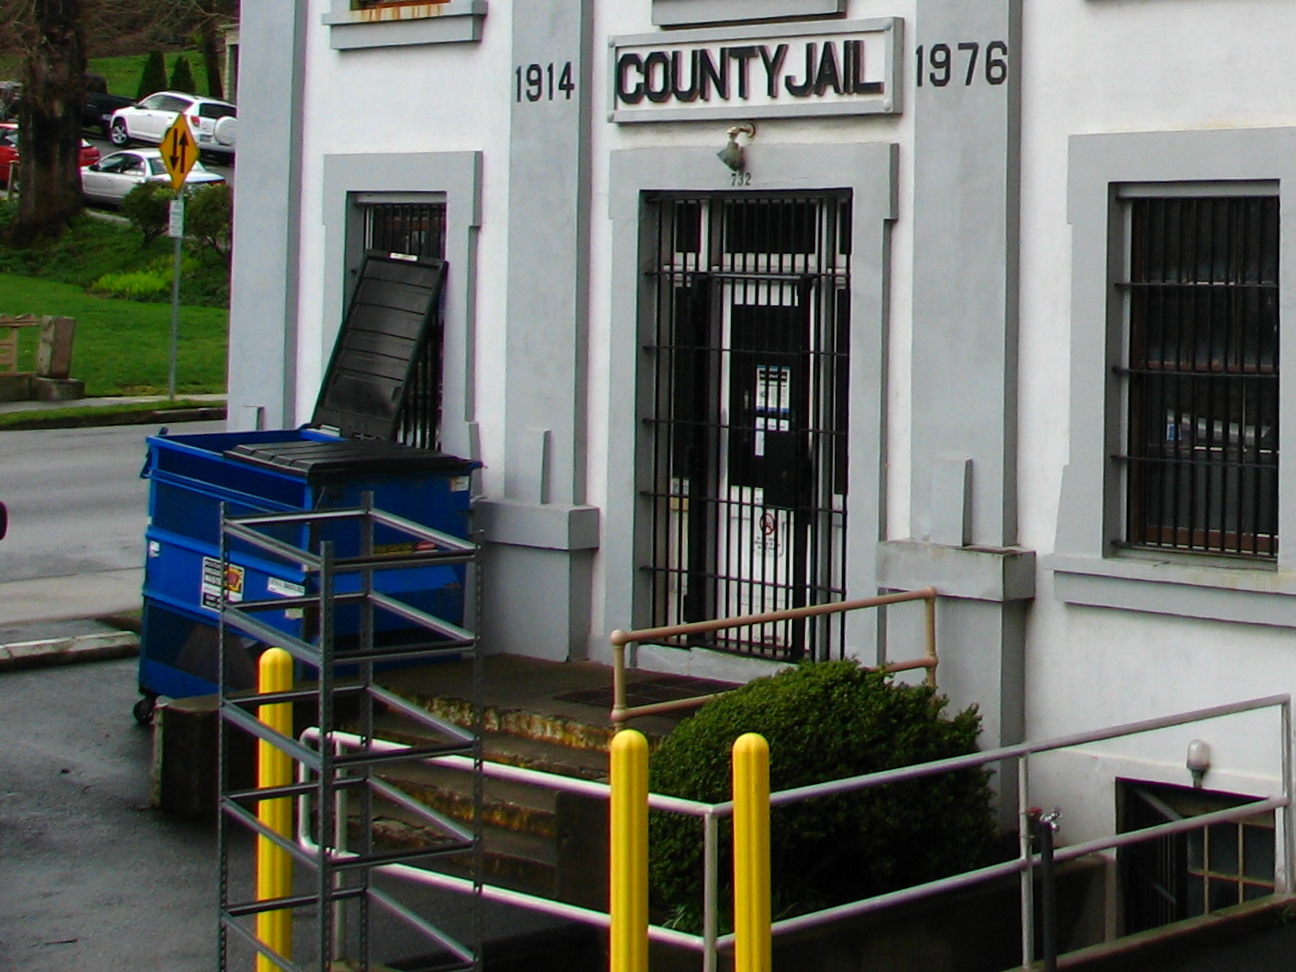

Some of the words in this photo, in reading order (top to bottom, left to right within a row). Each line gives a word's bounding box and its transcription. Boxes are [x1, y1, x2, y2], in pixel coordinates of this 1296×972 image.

[516, 62, 575, 102] 1914
[916, 41, 1007, 87] 1976
[731, 172, 752, 187] 732
